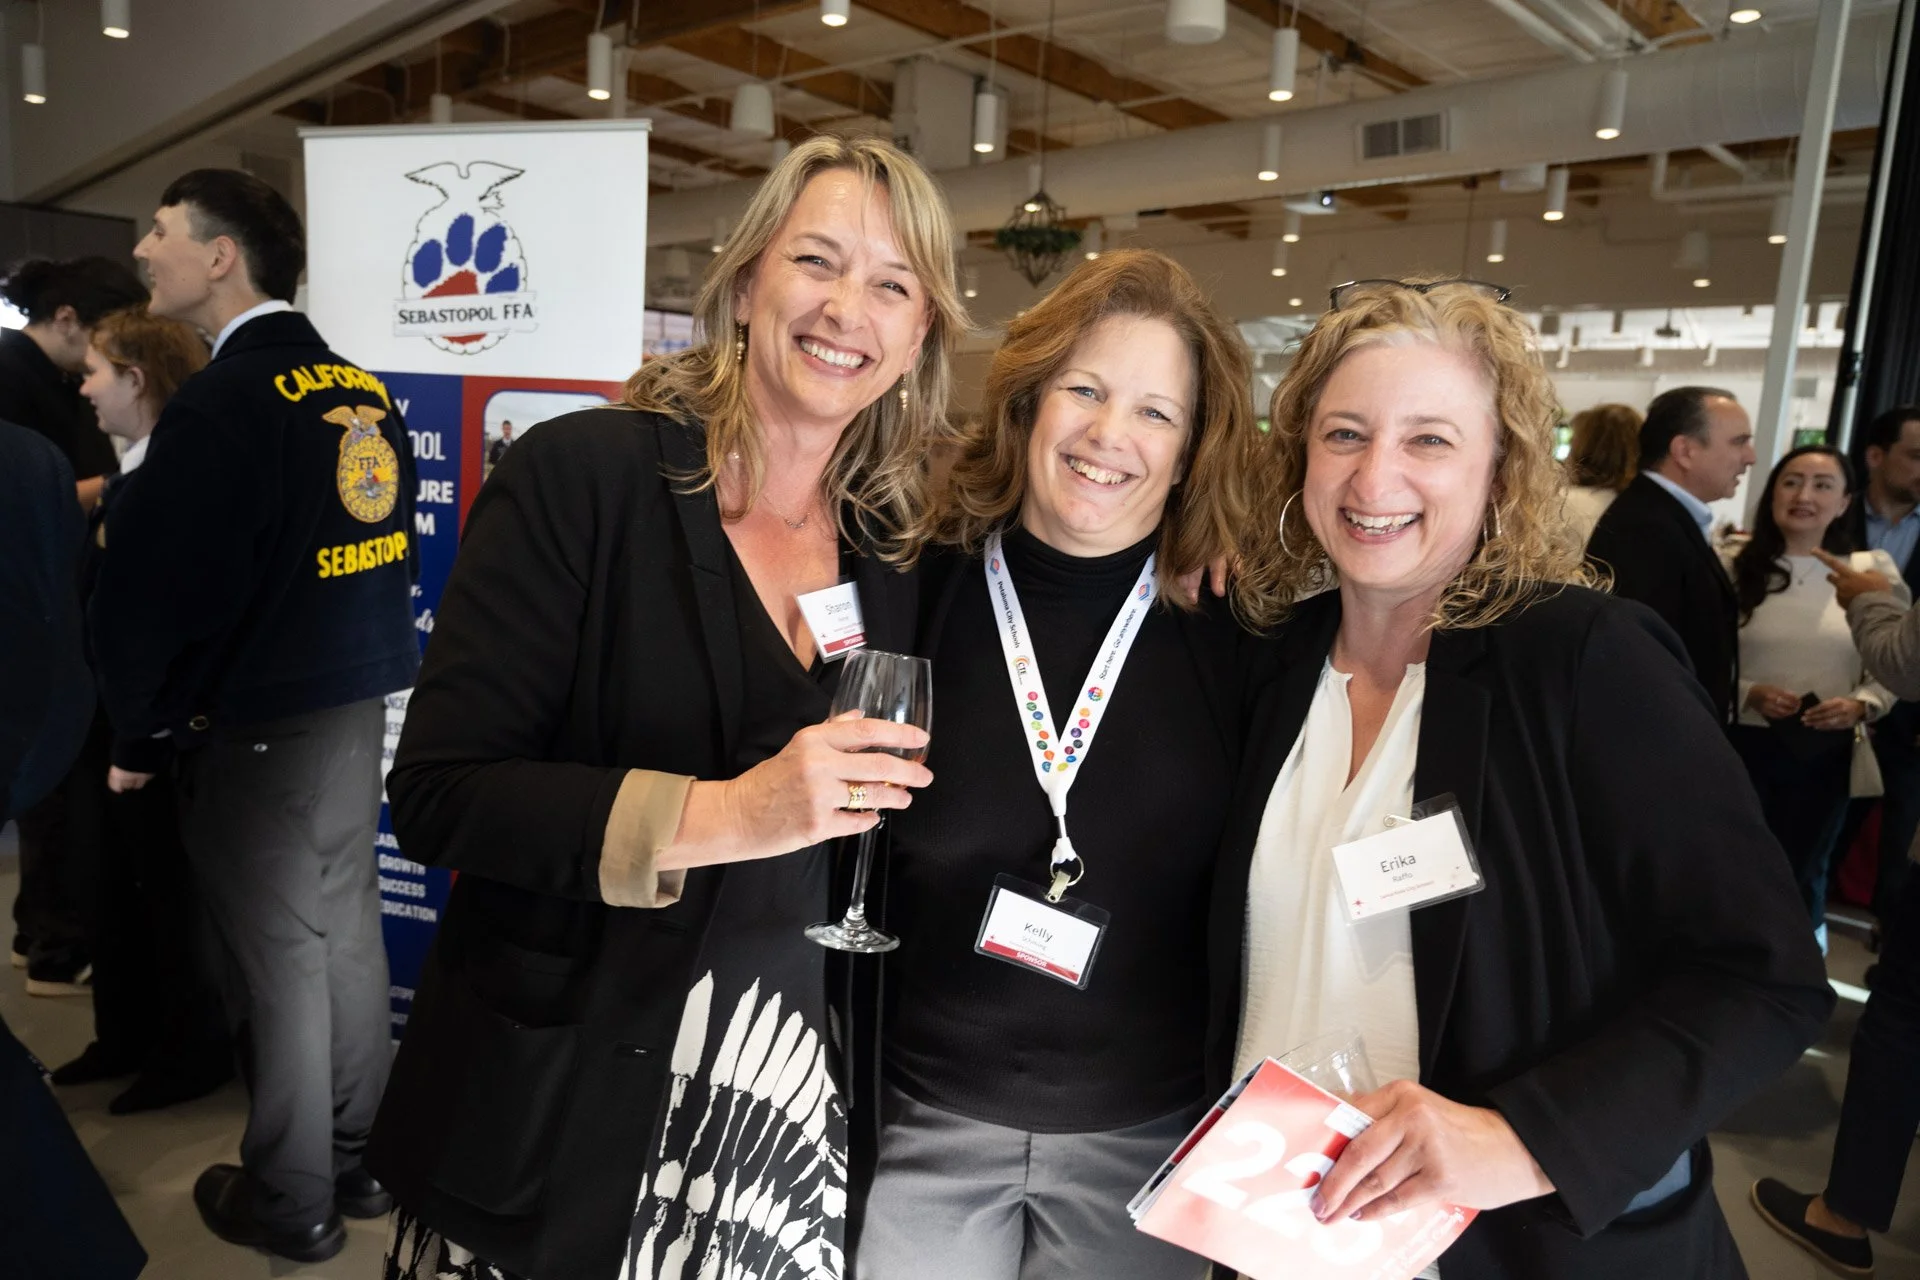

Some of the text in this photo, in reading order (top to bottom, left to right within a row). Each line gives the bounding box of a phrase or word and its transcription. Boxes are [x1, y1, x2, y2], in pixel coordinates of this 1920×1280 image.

[398, 303, 533, 325] SEBASTOPOL FFA
[359, 456, 381, 471] FFA
[317, 530, 408, 578] SEBASTOP
[997, 582, 1020, 648] Petaluma City Schools
[1099, 664, 1109, 680] Start
[378, 853, 426, 876] GROWTH
[1380, 853, 1417, 873] Erika
[1024, 921, 1054, 943] Kelly
[1016, 951, 1048, 968] SPONSOR
